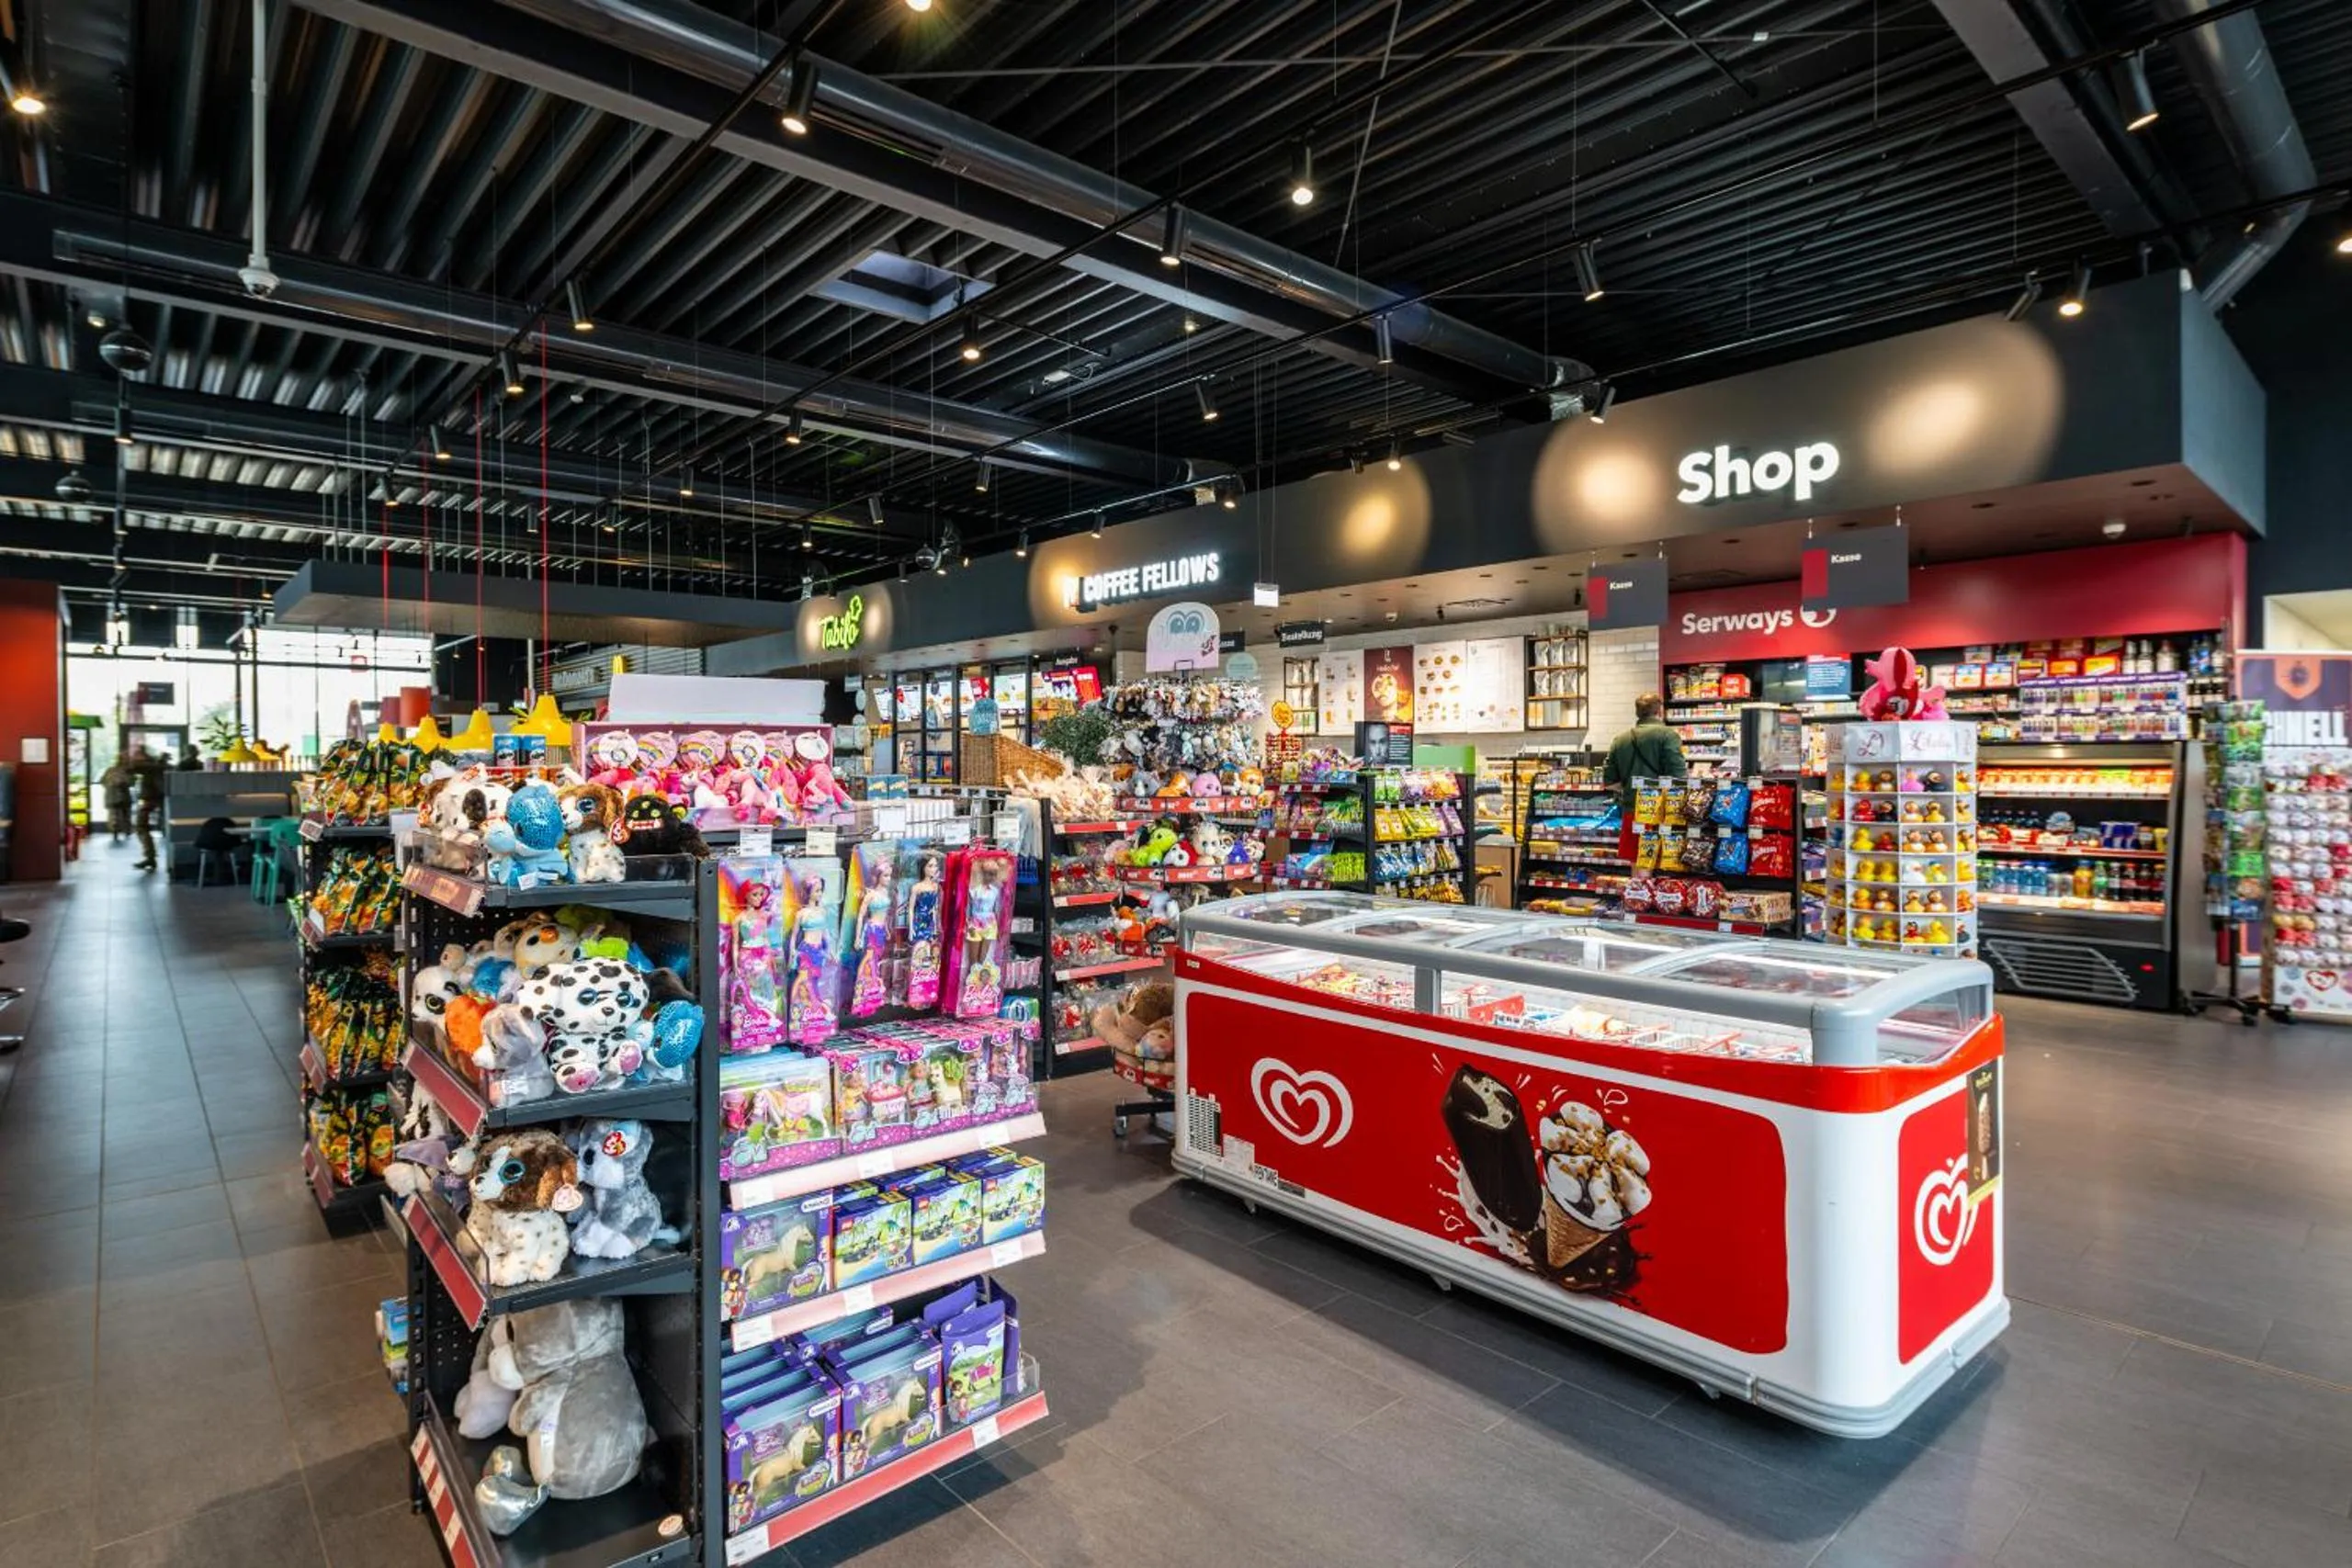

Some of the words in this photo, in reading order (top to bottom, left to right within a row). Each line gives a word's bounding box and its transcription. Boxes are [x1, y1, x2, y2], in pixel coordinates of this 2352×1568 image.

[1678, 441, 1839, 503] Shop
[1830, 552, 1862, 564] Kasse
[1083, 567, 1140, 603] COFFEE
[1142, 553, 1220, 592] FELLOWS
[1610, 581, 1634, 591] Kasse
[1681, 605, 1793, 635] Serways
[963, 984, 996, 1002] Barbie
